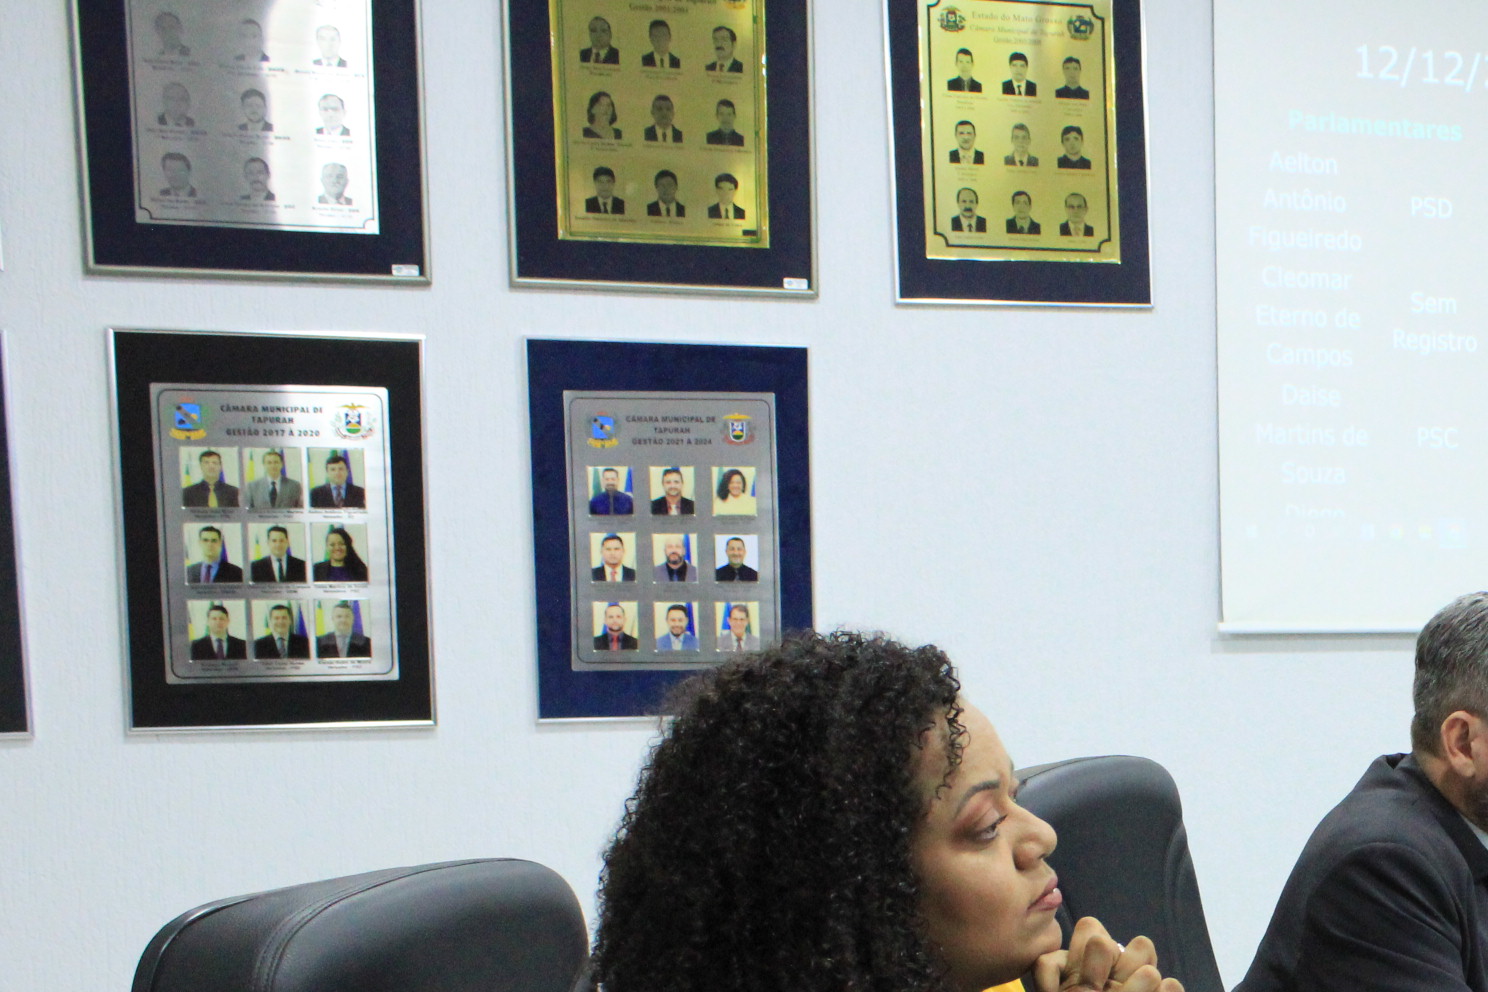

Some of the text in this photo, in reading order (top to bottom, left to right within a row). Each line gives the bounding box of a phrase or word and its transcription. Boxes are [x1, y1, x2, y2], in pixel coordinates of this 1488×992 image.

[1288, 109, 1463, 142] Parlamentares
[1263, 188, 1347, 213] Antônio
[1410, 196, 1453, 219] PSD
[1249, 225, 1363, 251] Figueiredo
[1261, 266, 1353, 290] Cleomar
[1410, 291, 1457, 314] Sem
[1255, 304, 1361, 330] Eterno de
[1393, 329, 1478, 355] Registro
[1266, 342, 1354, 369] Campos
[1281, 384, 1342, 407] Daise
[220, 403, 259, 413] CÂMARA
[261, 405, 310, 414] MUNICIPAL
[251, 416, 294, 424] TAPURAH
[661, 415, 704, 423] MUNICIPAL
[1255, 423, 1370, 447] Martins de
[1416, 427, 1459, 450] PSC
[1281, 461, 1346, 485] Souza
